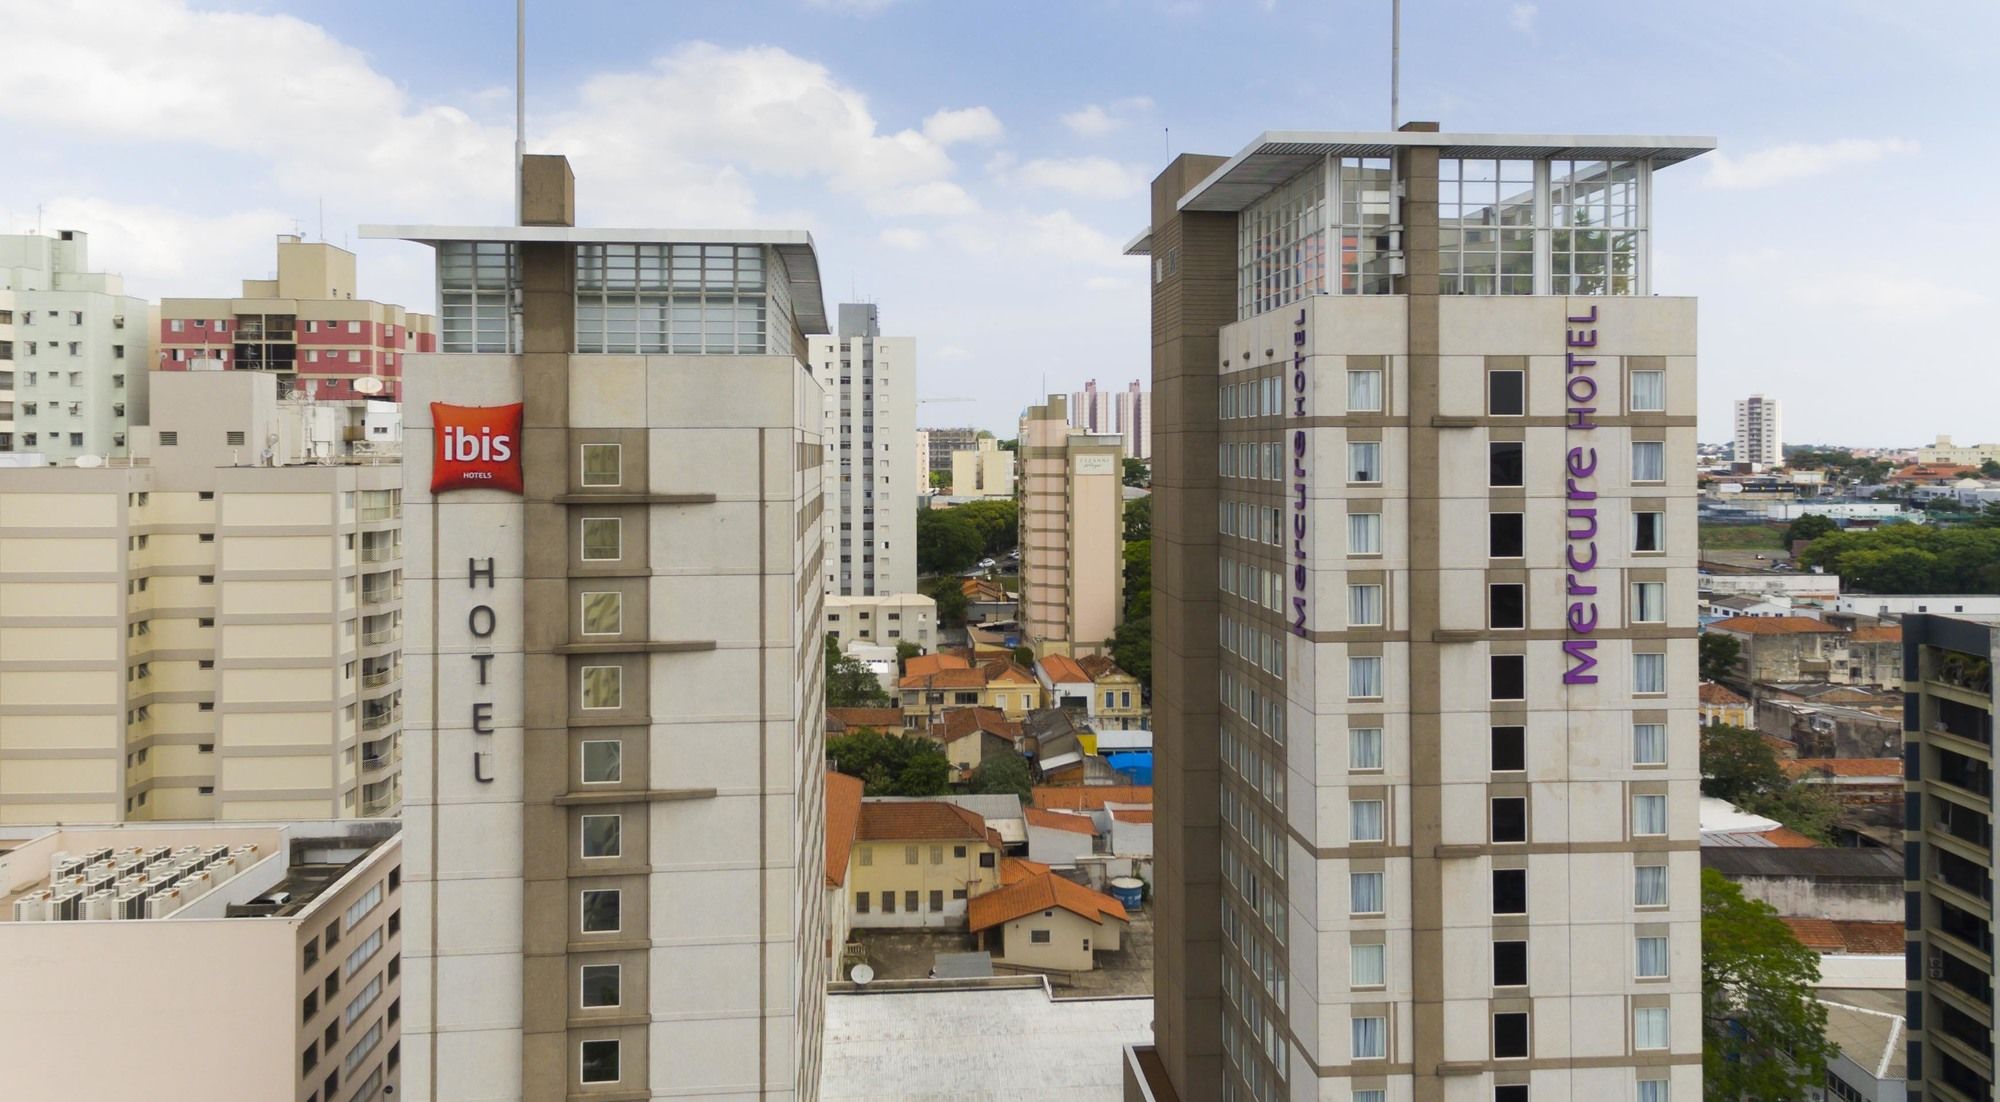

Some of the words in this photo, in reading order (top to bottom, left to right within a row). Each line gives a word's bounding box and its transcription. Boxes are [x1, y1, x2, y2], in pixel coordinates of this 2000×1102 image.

[444, 426, 511, 462] ibis
[1293, 309, 1306, 416] HOTEL
[1567, 305, 1598, 430] HOTEL
[1293, 430, 1307, 638] Mercure
[1562, 446, 1598, 685] Mercure
[468, 557, 497, 783] HOTEL
